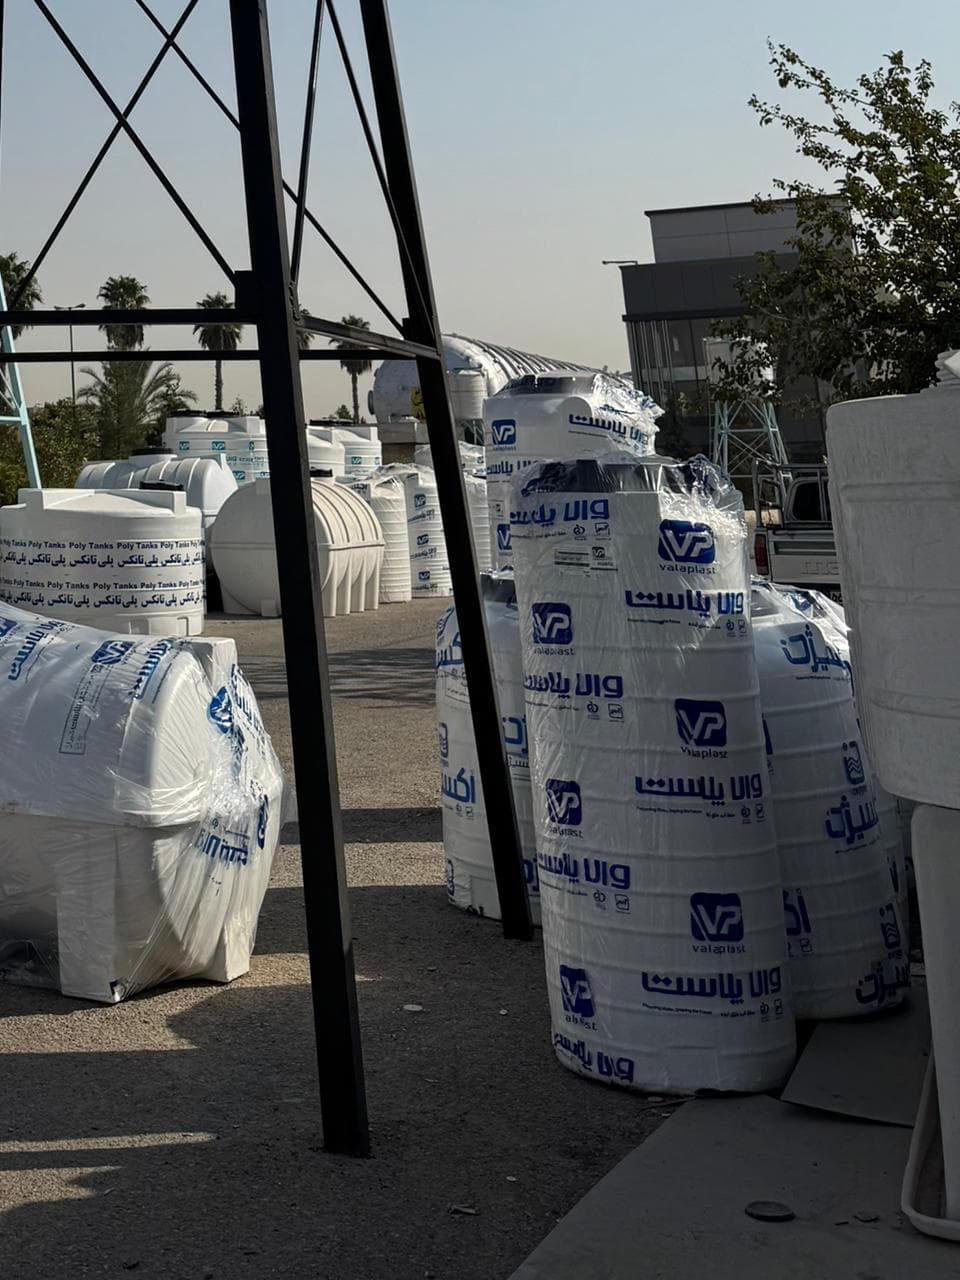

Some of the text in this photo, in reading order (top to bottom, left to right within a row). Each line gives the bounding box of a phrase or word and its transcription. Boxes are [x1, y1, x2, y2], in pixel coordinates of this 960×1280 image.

[493, 422, 516, 444] VP
[568, 413, 627, 438] پلاست
[486, 460, 514, 477] پلاس
[414, 494, 426, 506] VP
[562, 499, 611, 522] والا
[28, 540, 43, 551] Poly
[44, 541, 66, 549] Tanks
[69, 541, 87, 551] Poly
[89, 542, 114, 550] Tanks
[116, 542, 134, 552] Poly
[136, 542, 158, 550] Tanks
[160, 541, 174, 551] Poly
[661, 526, 714, 560] VP
[28, 553, 51, 566] تانکس
[51, 554, 66, 568] پلی
[69, 553, 97, 567] تانکس
[97, 554, 114, 569] پلی
[117, 553, 144, 568] تانکس
[144, 554, 159, 568] پلی
[160, 553, 181, 566] تانکس
[659, 563, 717, 575] valaplast
[25, 580, 45, 589] Tanks
[47, 580, 65, 591] Poly
[66, 581, 90, 590] Tanks
[92, 582, 111, 592] Poly
[114, 582, 138, 590] Tanks
[140, 582, 156, 592] Poly
[157, 581, 177, 589] Tanks
[13, 592, 31, 604] تانکس
[31, 593, 45, 606] پلی
[47, 594, 73, 607] تانکس
[73, 596, 90, 609] پلی
[93, 595, 122, 609] تانکس
[122, 596, 138, 609] پلی
[141, 595, 165, 608] تانکس
[165, 594, 178, 608] پلی
[624, 589, 744, 618] والا پلاست
[533, 608, 572, 641] VP
[7, 629, 45, 682] پلاست
[575, 673, 624, 699] والا
[677, 706, 725, 742] VP
[635, 773, 763, 807] والا پلاست
[547, 785, 581, 822] VP
[825, 795, 879, 845] سیژن
[583, 858, 631, 890] والا
[692, 899, 743, 939] VP
[692, 943, 746, 956] valaplast
[641, 966, 782, 1005] والا پلاست
[596, 1051, 635, 1083] والا
